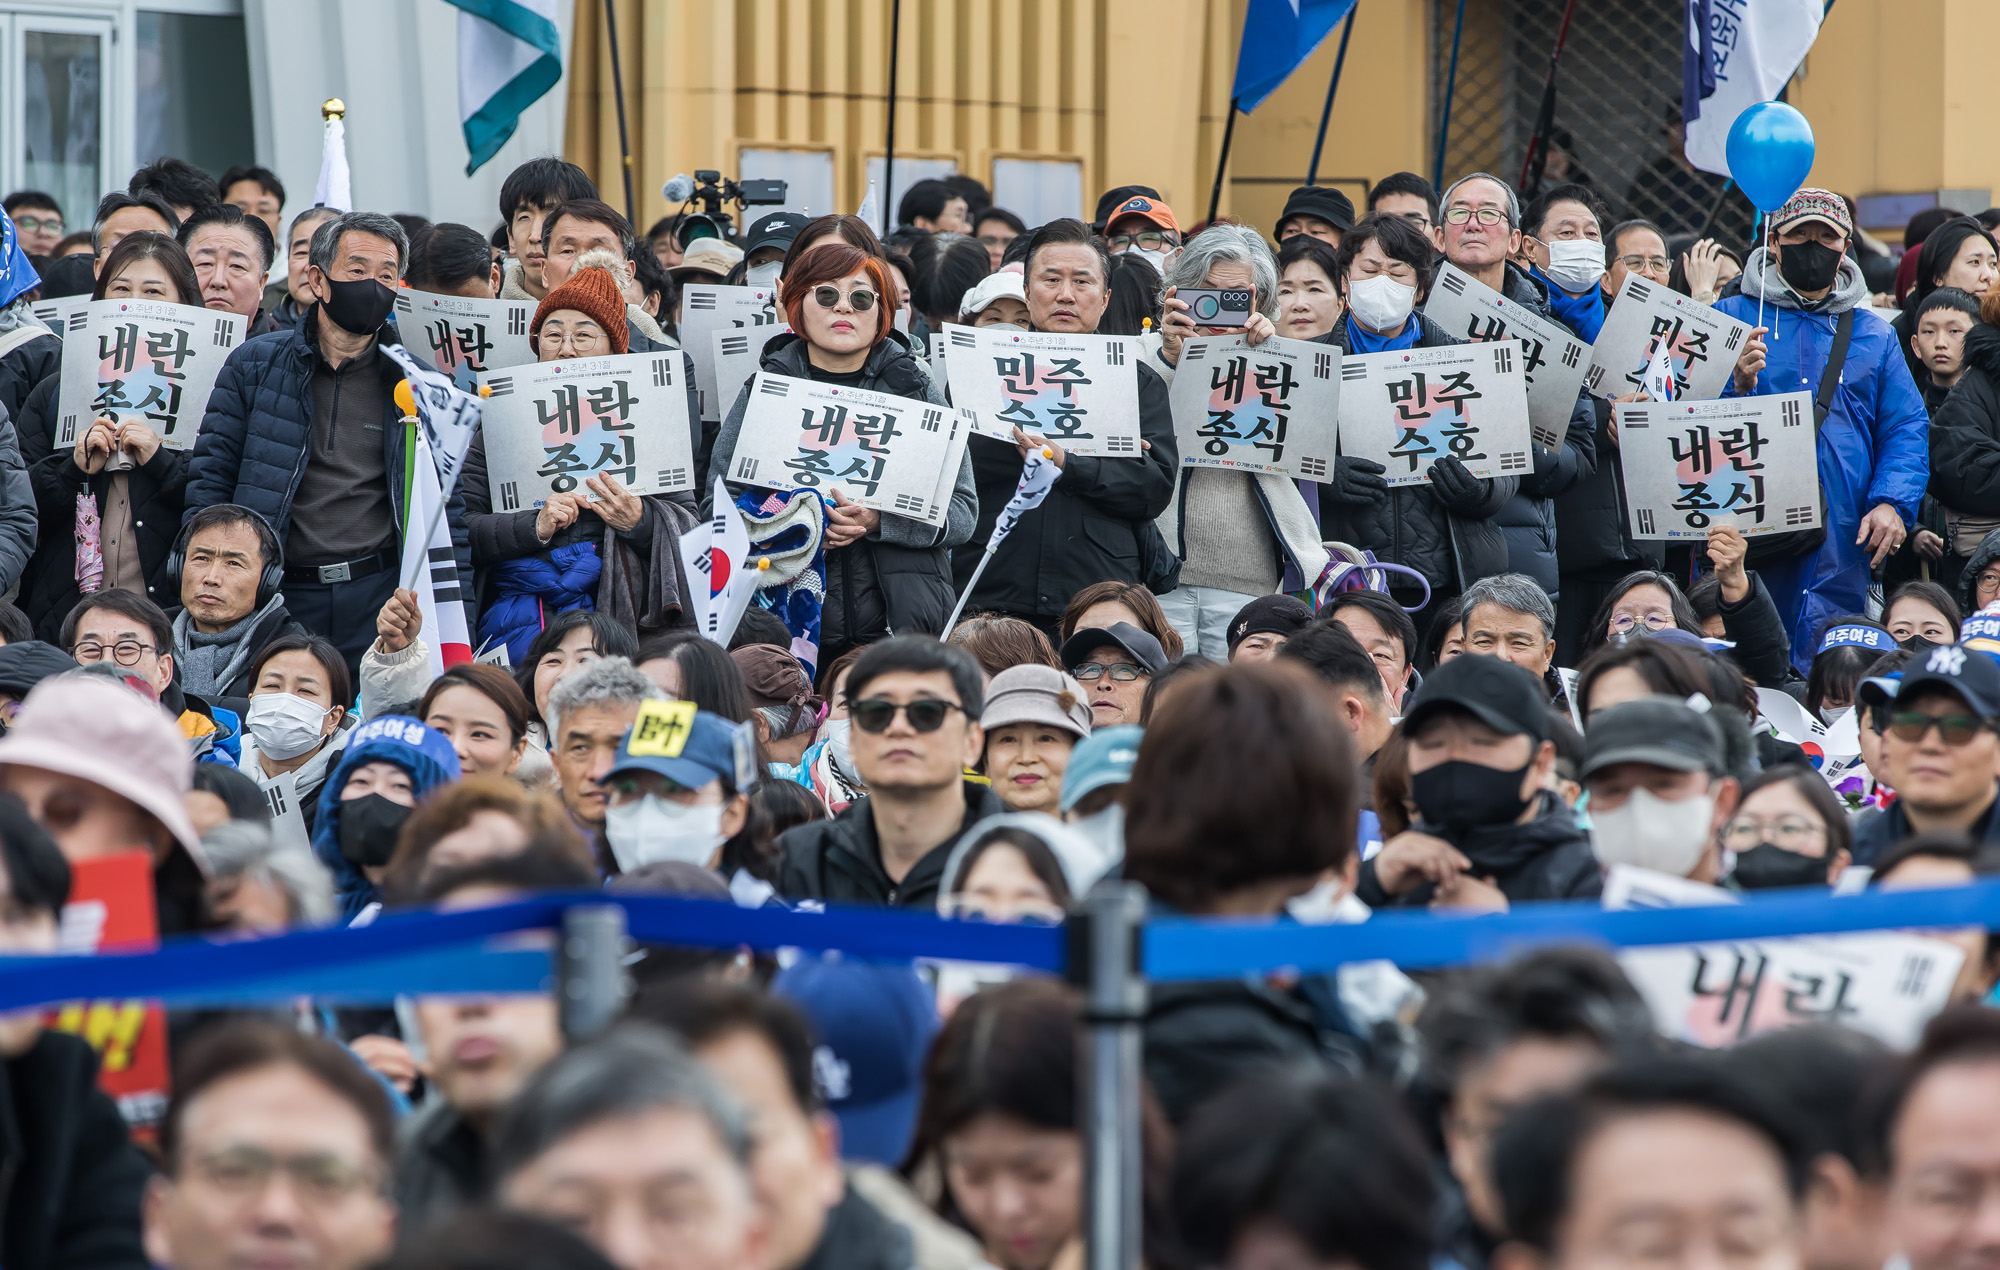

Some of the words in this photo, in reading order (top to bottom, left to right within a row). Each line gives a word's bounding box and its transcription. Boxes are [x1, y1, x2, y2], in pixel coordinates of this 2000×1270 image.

[97, 323, 196, 380] 내란
[424, 318, 495, 372] 내란
[1649, 315, 1709, 370] 민주
[994, 352, 1092, 397] 민주
[1210, 355, 1299, 411] 내란
[1385, 371, 1482, 420] 민주
[90, 380, 182, 435] 종식
[533, 380, 639, 436] 내란
[800, 404, 903, 455] 내란
[996, 400, 1094, 440] 수호
[1196, 411, 1289, 462] 종식
[1388, 422, 1487, 472] 수호
[1668, 422, 1769, 475] 내란
[537, 435, 636, 493] 종식
[783, 446, 887, 498] 종식
[1672, 475, 1766, 530] 종식
[1825, 627, 1879, 646] 민주여성
[1961, 619, 2000, 643] 민주여
[351, 718, 426, 749] 민주여성
